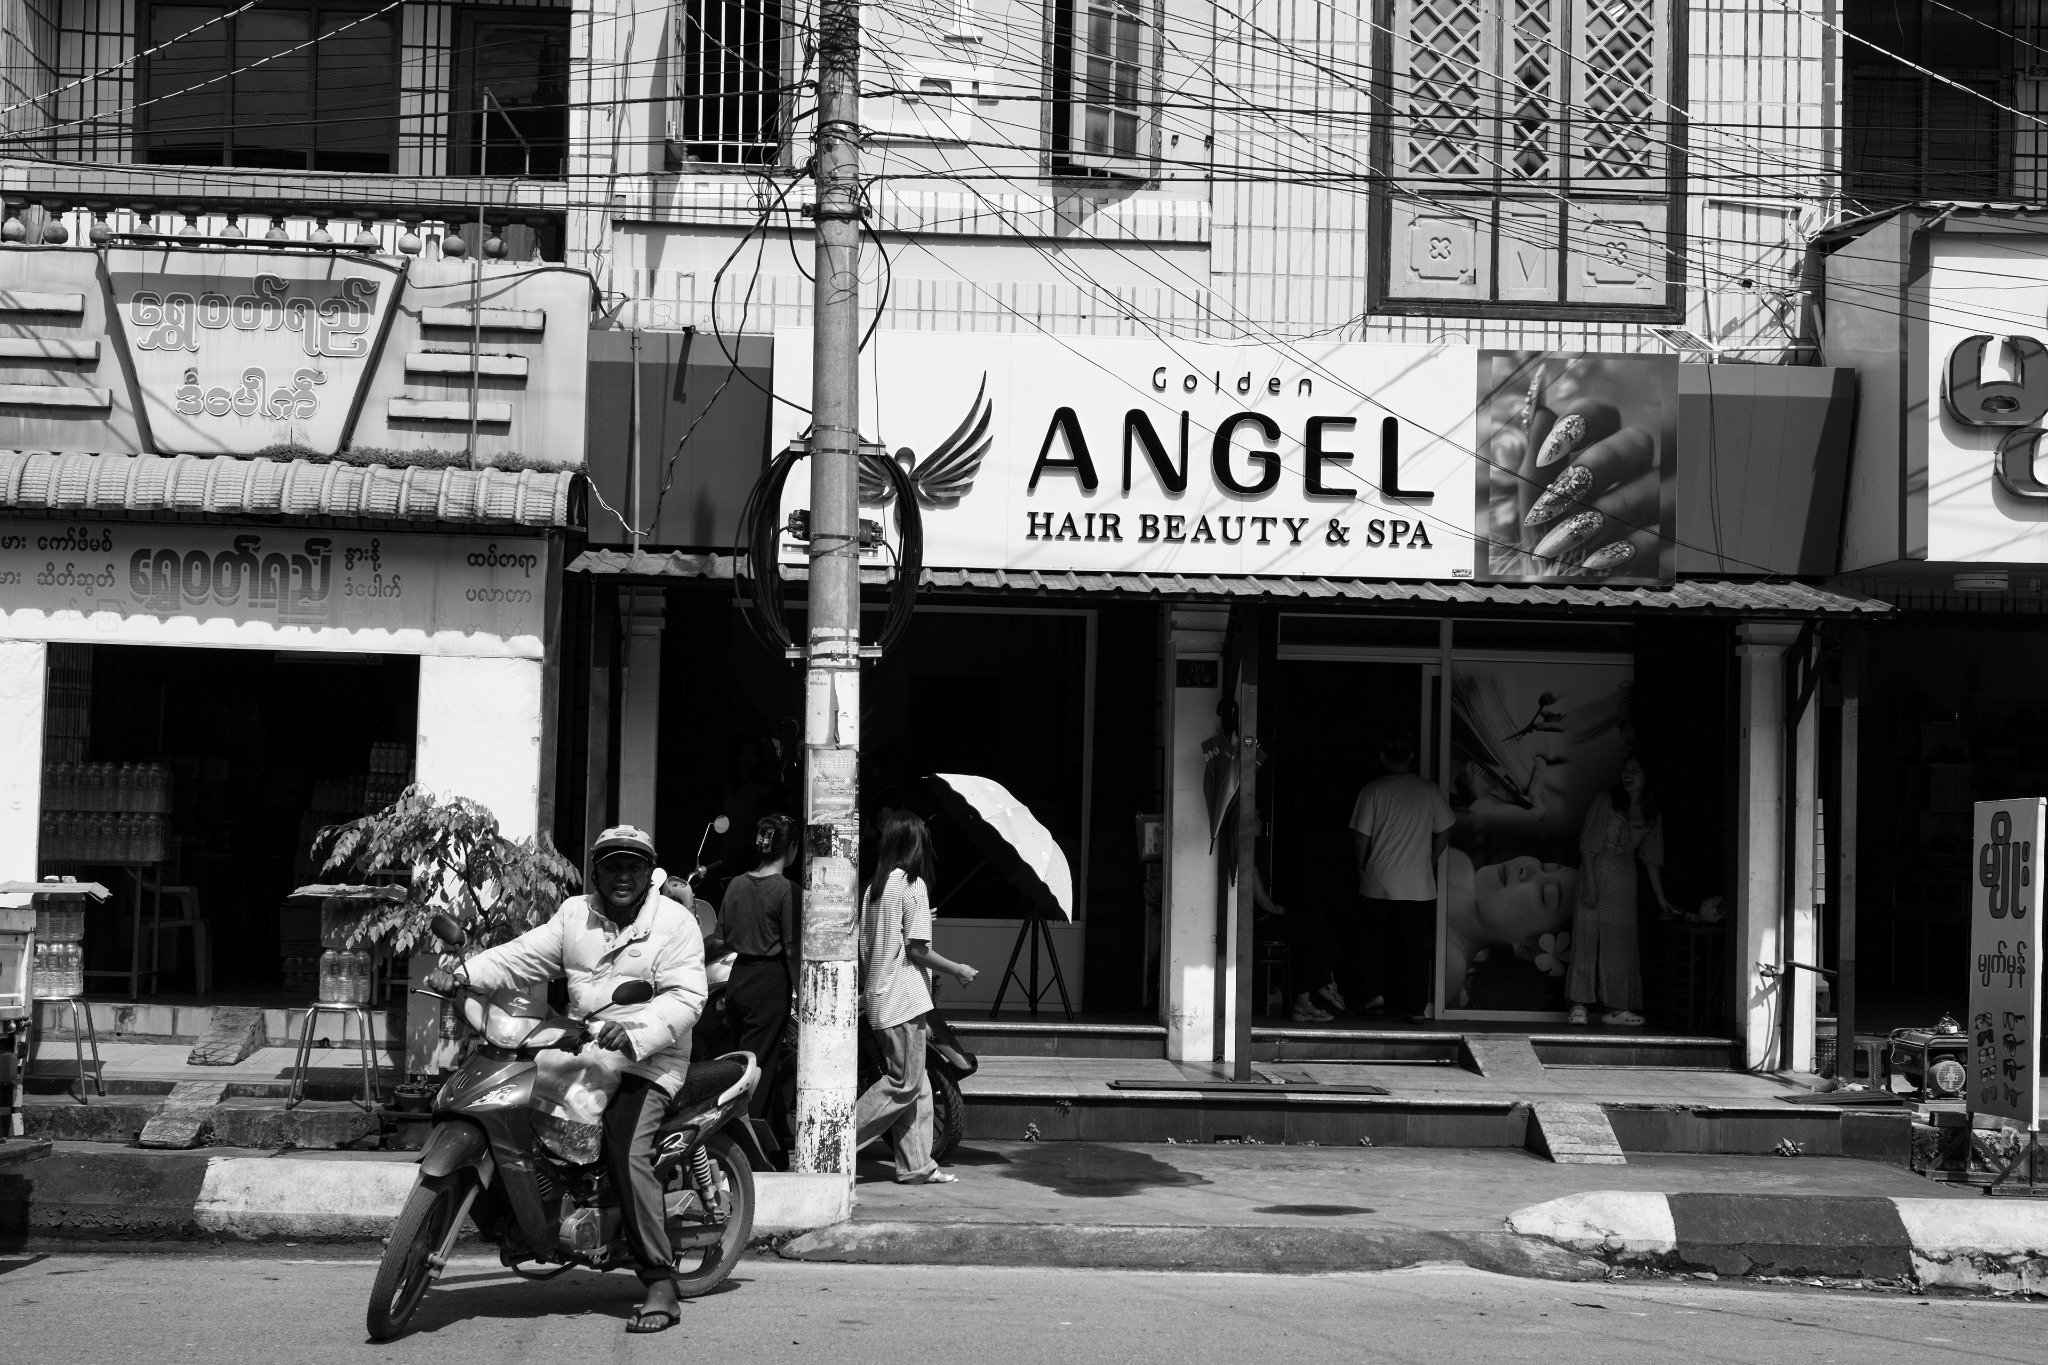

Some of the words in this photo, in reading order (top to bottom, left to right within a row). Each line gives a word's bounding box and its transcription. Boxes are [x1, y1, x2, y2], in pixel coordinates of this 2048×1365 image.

[175, 365, 327, 420] ဒံပေါက်
[1152, 366, 1312, 395] Golden
[1028, 406, 1435, 502] ANGEL
[1026, 511, 1124, 541] HAIR
[1138, 513, 1310, 545] BEAUTY
[1325, 518, 1350, 545] &
[1367, 518, 1434, 548] SPA
